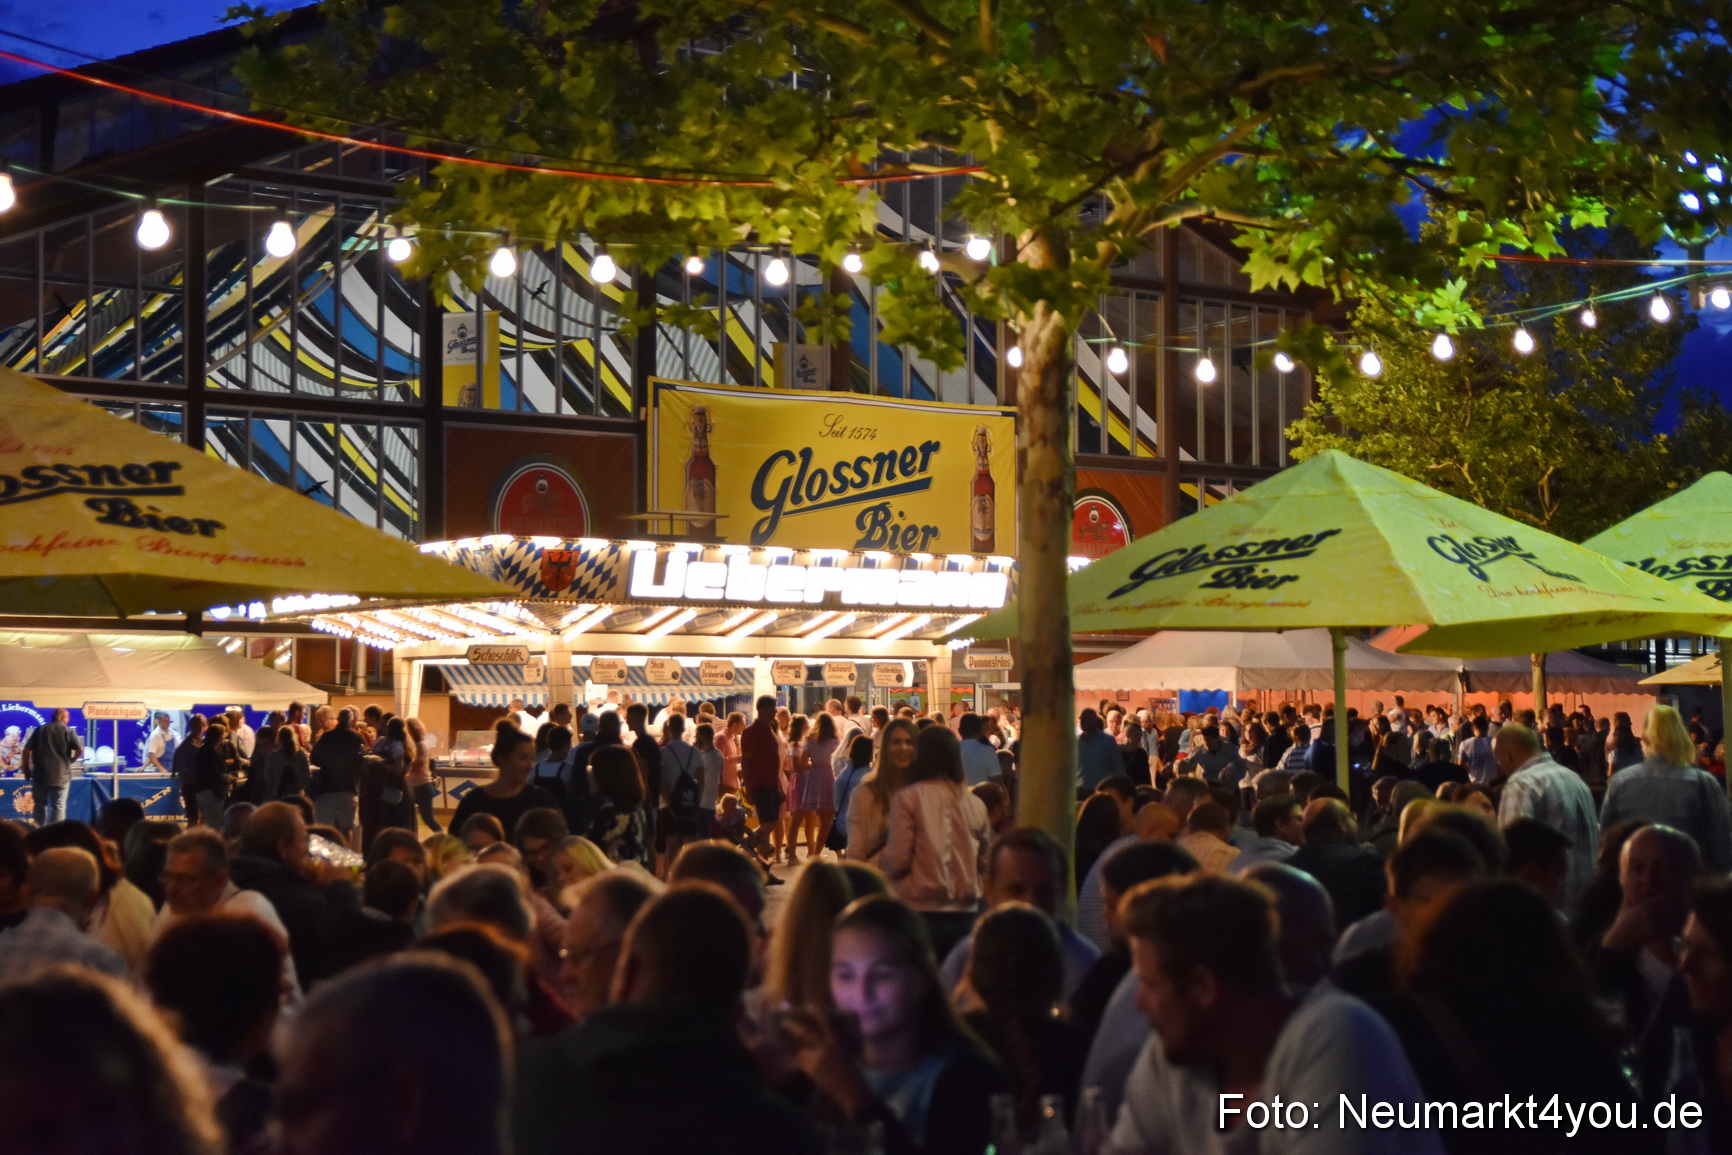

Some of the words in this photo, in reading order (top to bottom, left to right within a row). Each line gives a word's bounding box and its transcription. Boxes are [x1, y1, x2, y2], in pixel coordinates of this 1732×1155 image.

[819, 413, 846, 439] Seit
[849, 425, 877, 440] 1574
[0, 461, 182, 500] ossner
[750, 439, 941, 546] Glossner
[84, 497, 227, 538] Bier
[853, 501, 941, 551] Bier
[1108, 528, 1342, 600] Glossner
[1199, 564, 1300, 590] Bier
[87, 705, 142, 718] Pfandrückgabe
